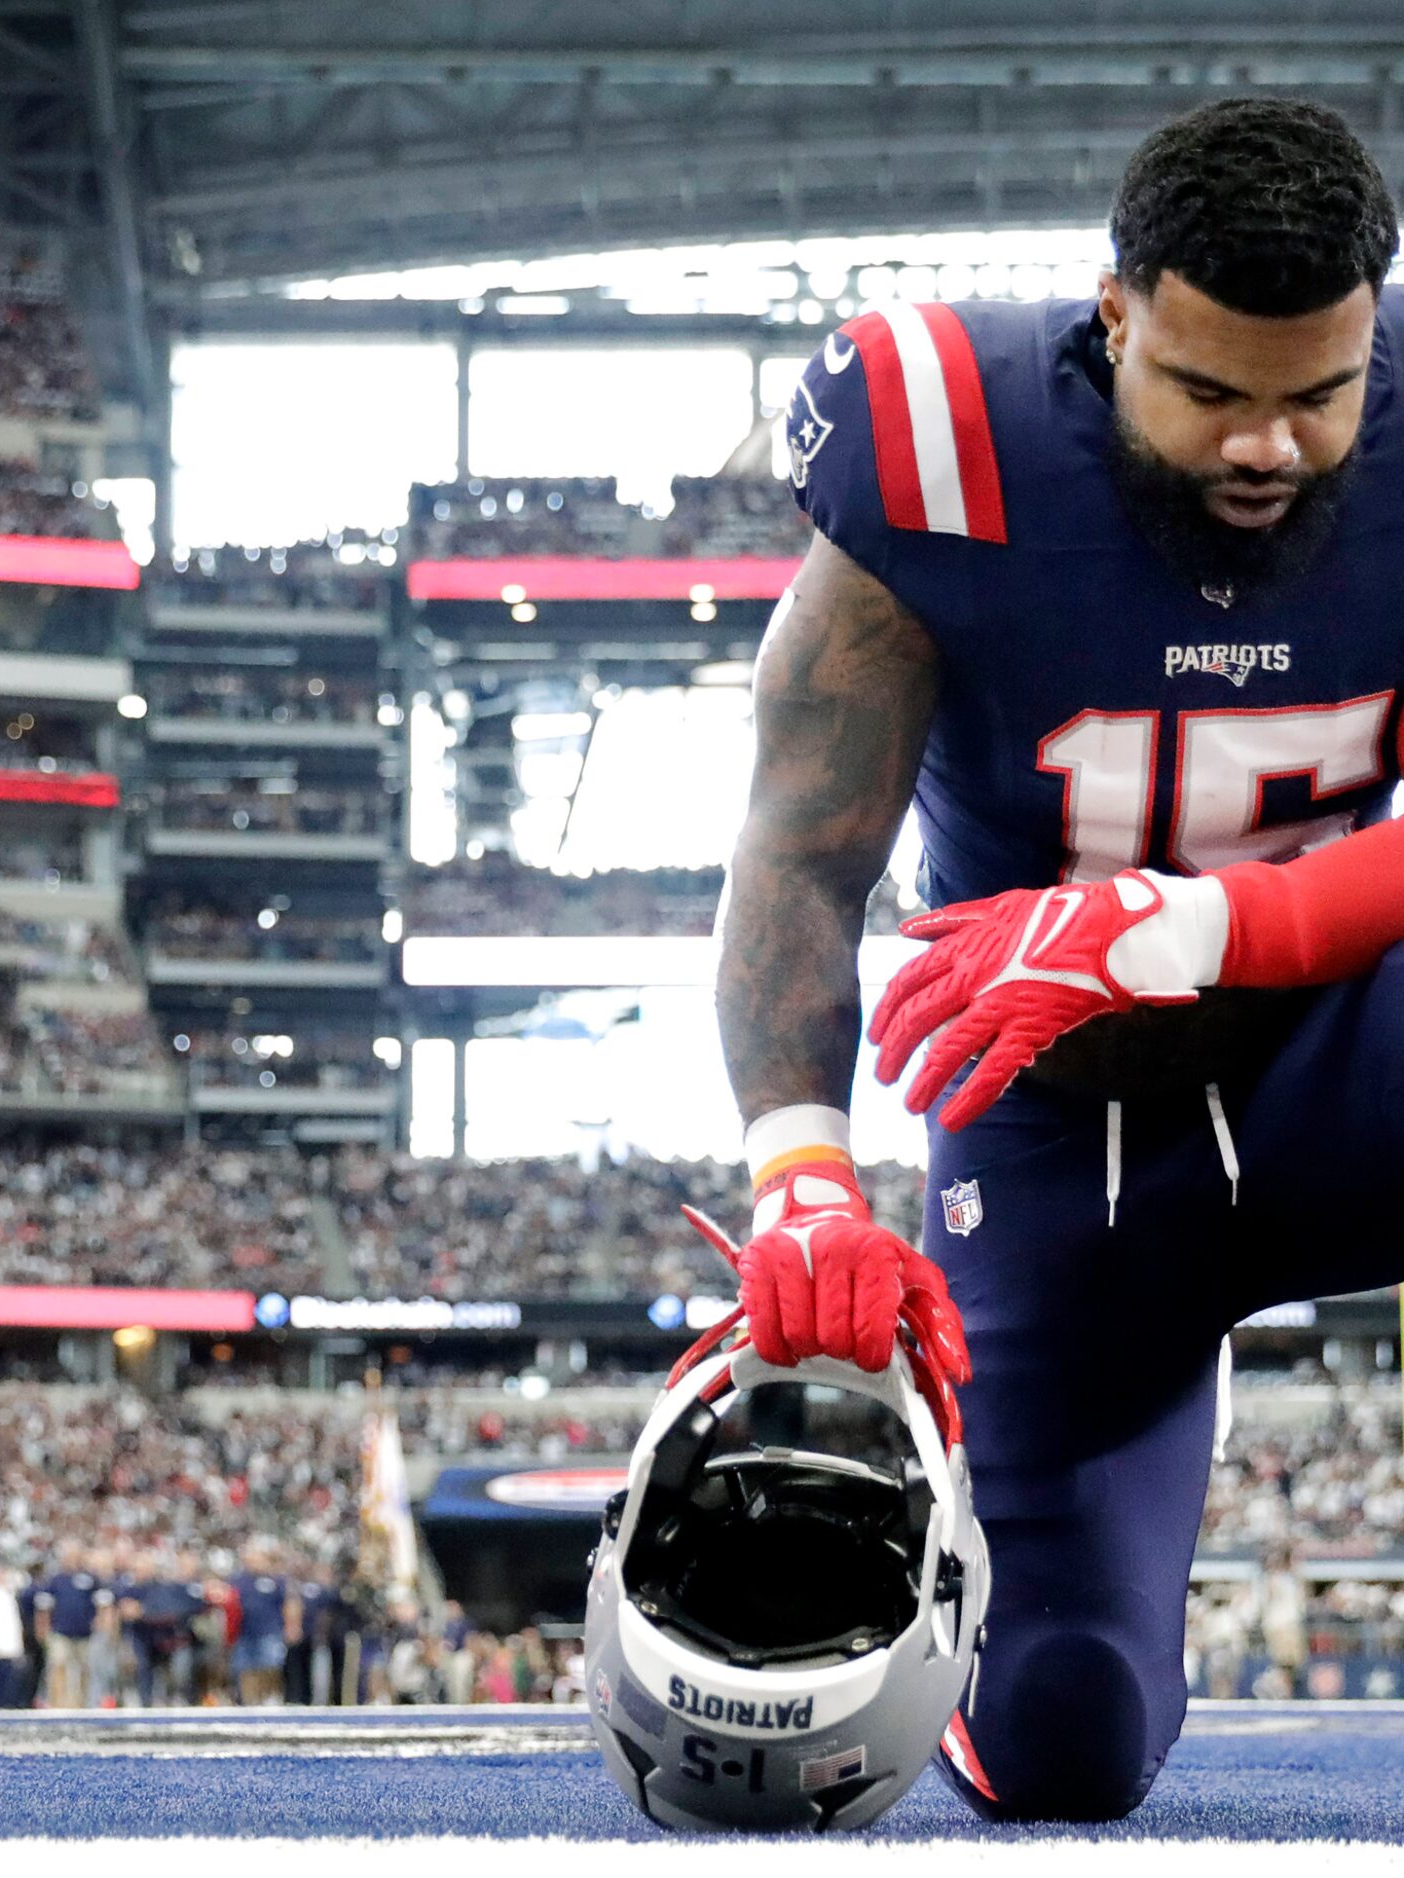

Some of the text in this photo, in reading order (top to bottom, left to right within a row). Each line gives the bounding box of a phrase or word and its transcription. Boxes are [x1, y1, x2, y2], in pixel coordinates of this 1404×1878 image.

[1164, 643, 1291, 679] PATRIOTS
[1035, 688, 1396, 885] 15
[950, 1203, 977, 1226] NFL
[667, 1673, 814, 1730] PATRIOTS
